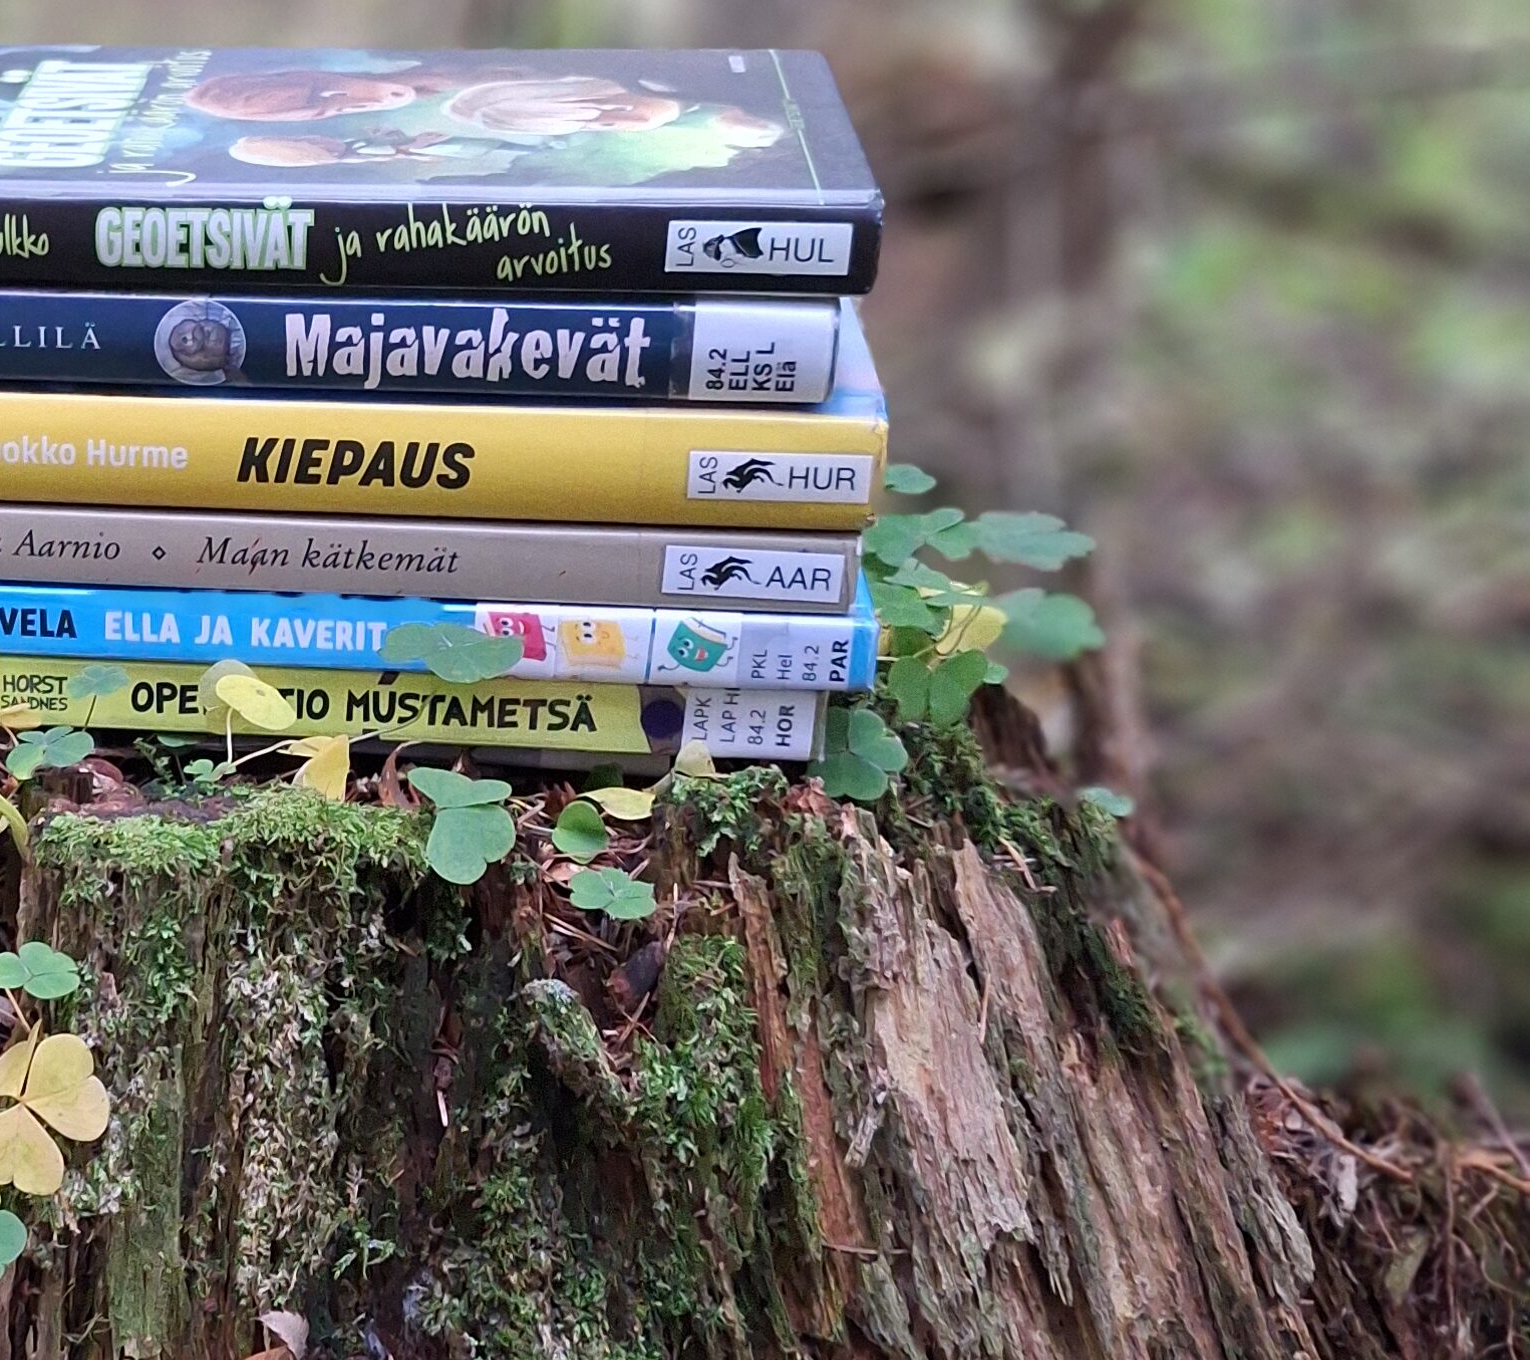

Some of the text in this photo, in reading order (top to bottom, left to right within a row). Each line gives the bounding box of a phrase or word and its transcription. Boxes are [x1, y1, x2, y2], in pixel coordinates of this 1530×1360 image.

[95, 195, 315, 270] GEOETSIVÄT
[320, 227, 362, 285] ja
[376, 202, 551, 253] rahakäärön
[497, 222, 612, 282] arvoitus
[676, 227, 697, 267] LAS
[770, 237, 834, 263] HUL
[284, 308, 651, 389] Majavakevät
[751, 341, 776, 391] KS L
[705, 348, 727, 390] 84.2
[728, 350, 751, 391] ELL
[775, 361, 797, 392] Elä
[87, 439, 189, 470] Hurme
[236, 437, 475, 490] KIEPAUS
[698, 456, 718, 494] LAS
[788, 466, 856, 491] HUR
[13, 528, 121, 560] Aarnio
[196, 536, 459, 574] Maan kätkemät
[678, 553, 698, 590] LAS
[766, 566, 832, 591] AAR
[105, 610, 387, 652] ELLA JA KAVERIT
[751, 650, 768, 679] PKL
[801, 645, 820, 681] 84.2
[829, 640, 850, 682] PAR
[1, 694, 68, 711] SANDNES
[3, 674, 68, 694] HORST
[131, 681, 597, 732] OPEIO MUSTAMETSÄ
[692, 696, 712, 741] LAPK
[719, 710, 737, 743] LAP
[747, 709, 767, 745] 84.2
[775, 705, 795, 747] HOR
